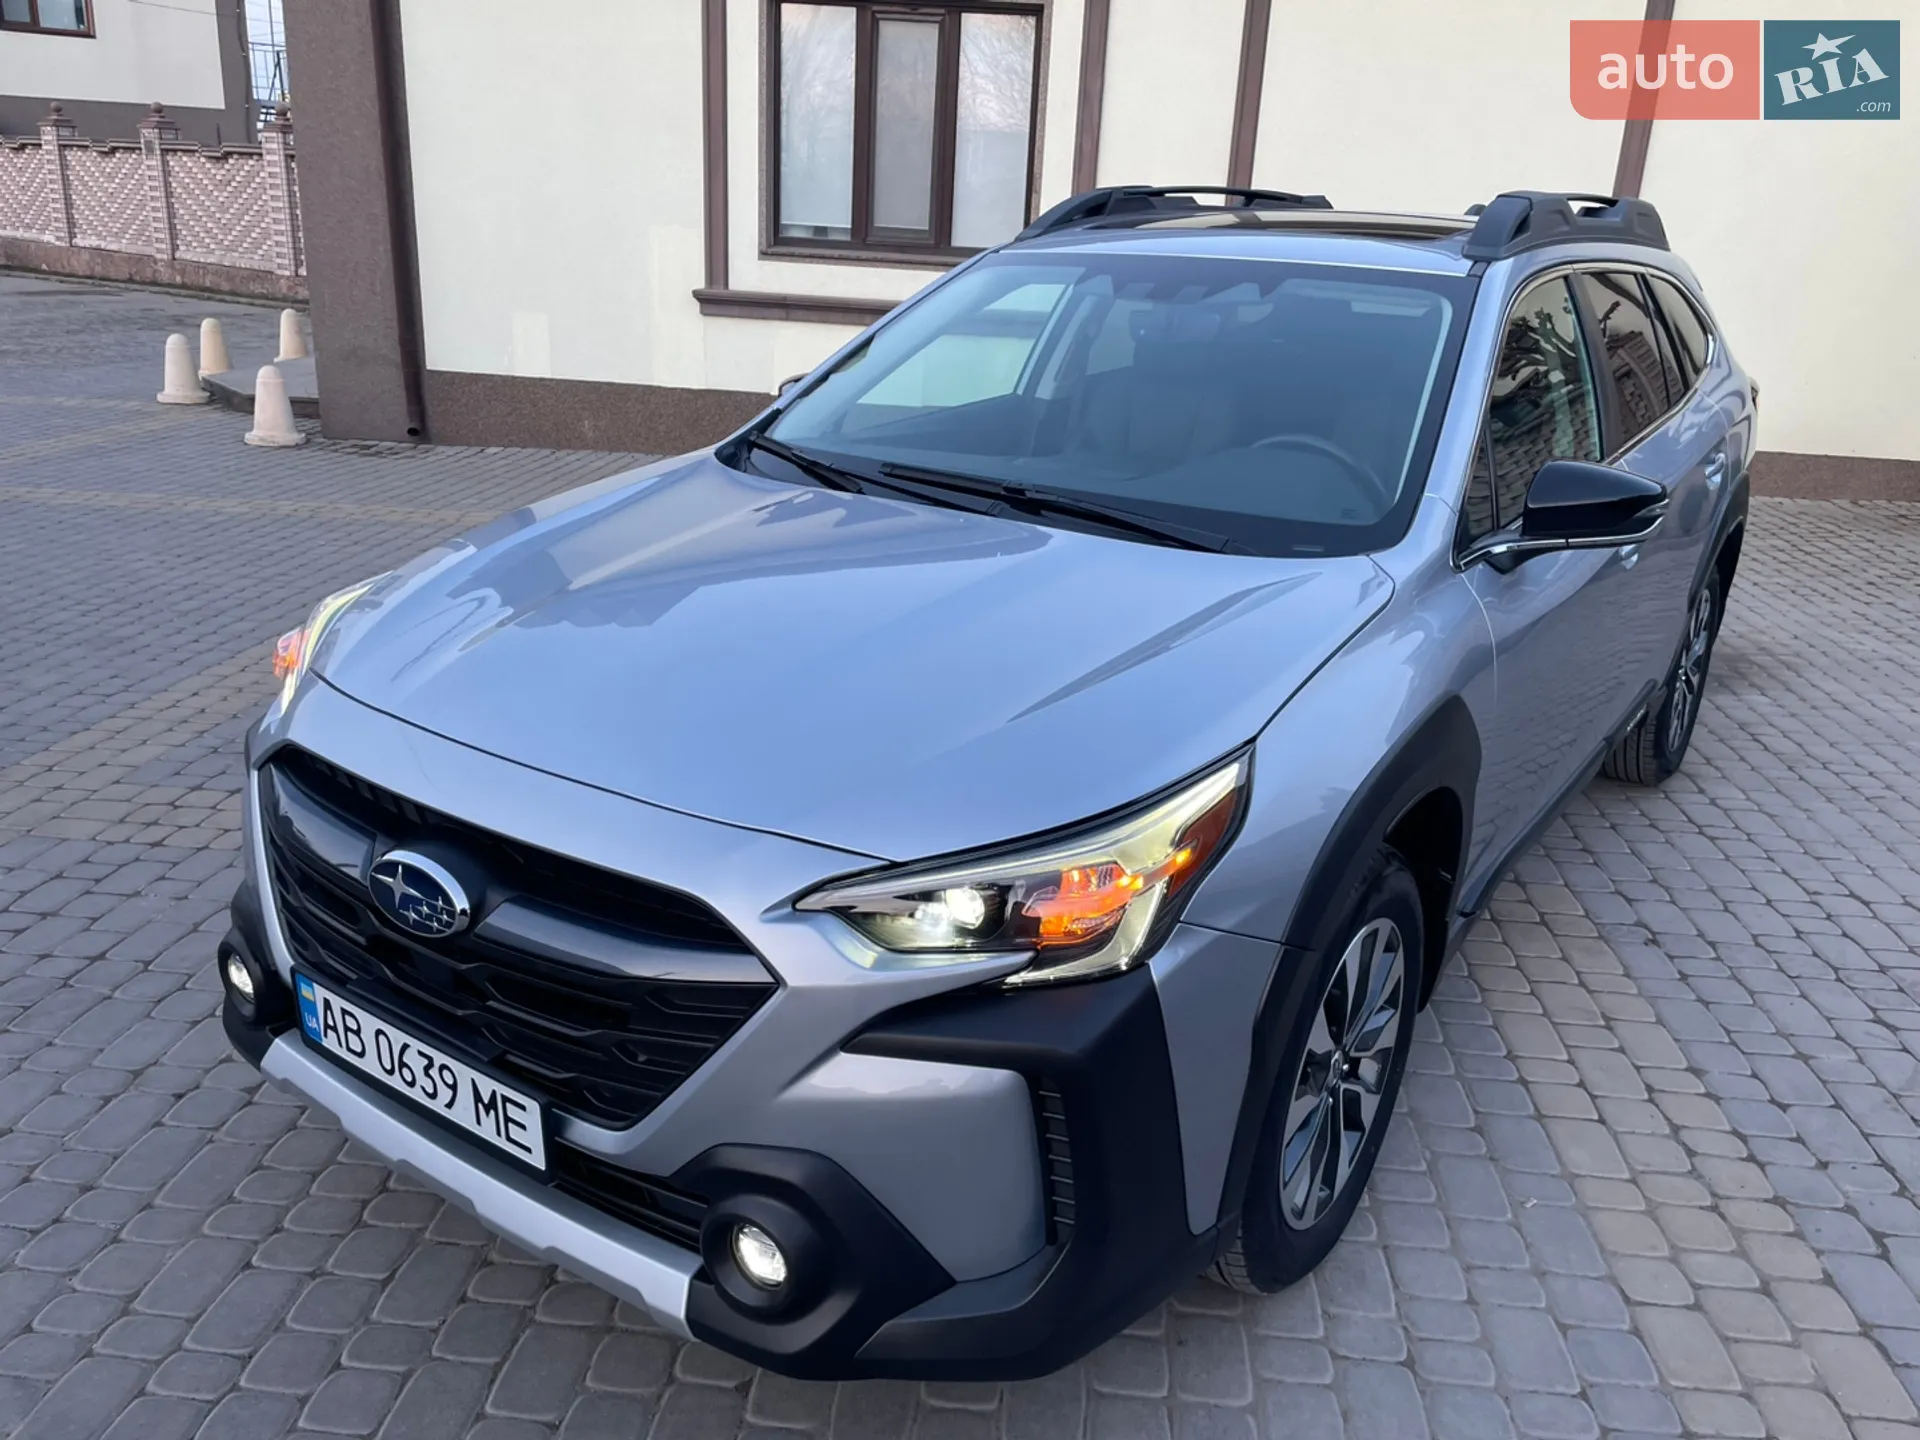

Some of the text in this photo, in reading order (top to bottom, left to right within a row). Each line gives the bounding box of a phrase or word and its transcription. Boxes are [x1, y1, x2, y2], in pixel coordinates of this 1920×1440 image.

[304, 1011, 320, 1031] UA
[322, 996, 533, 1155] AB 0639 ME
